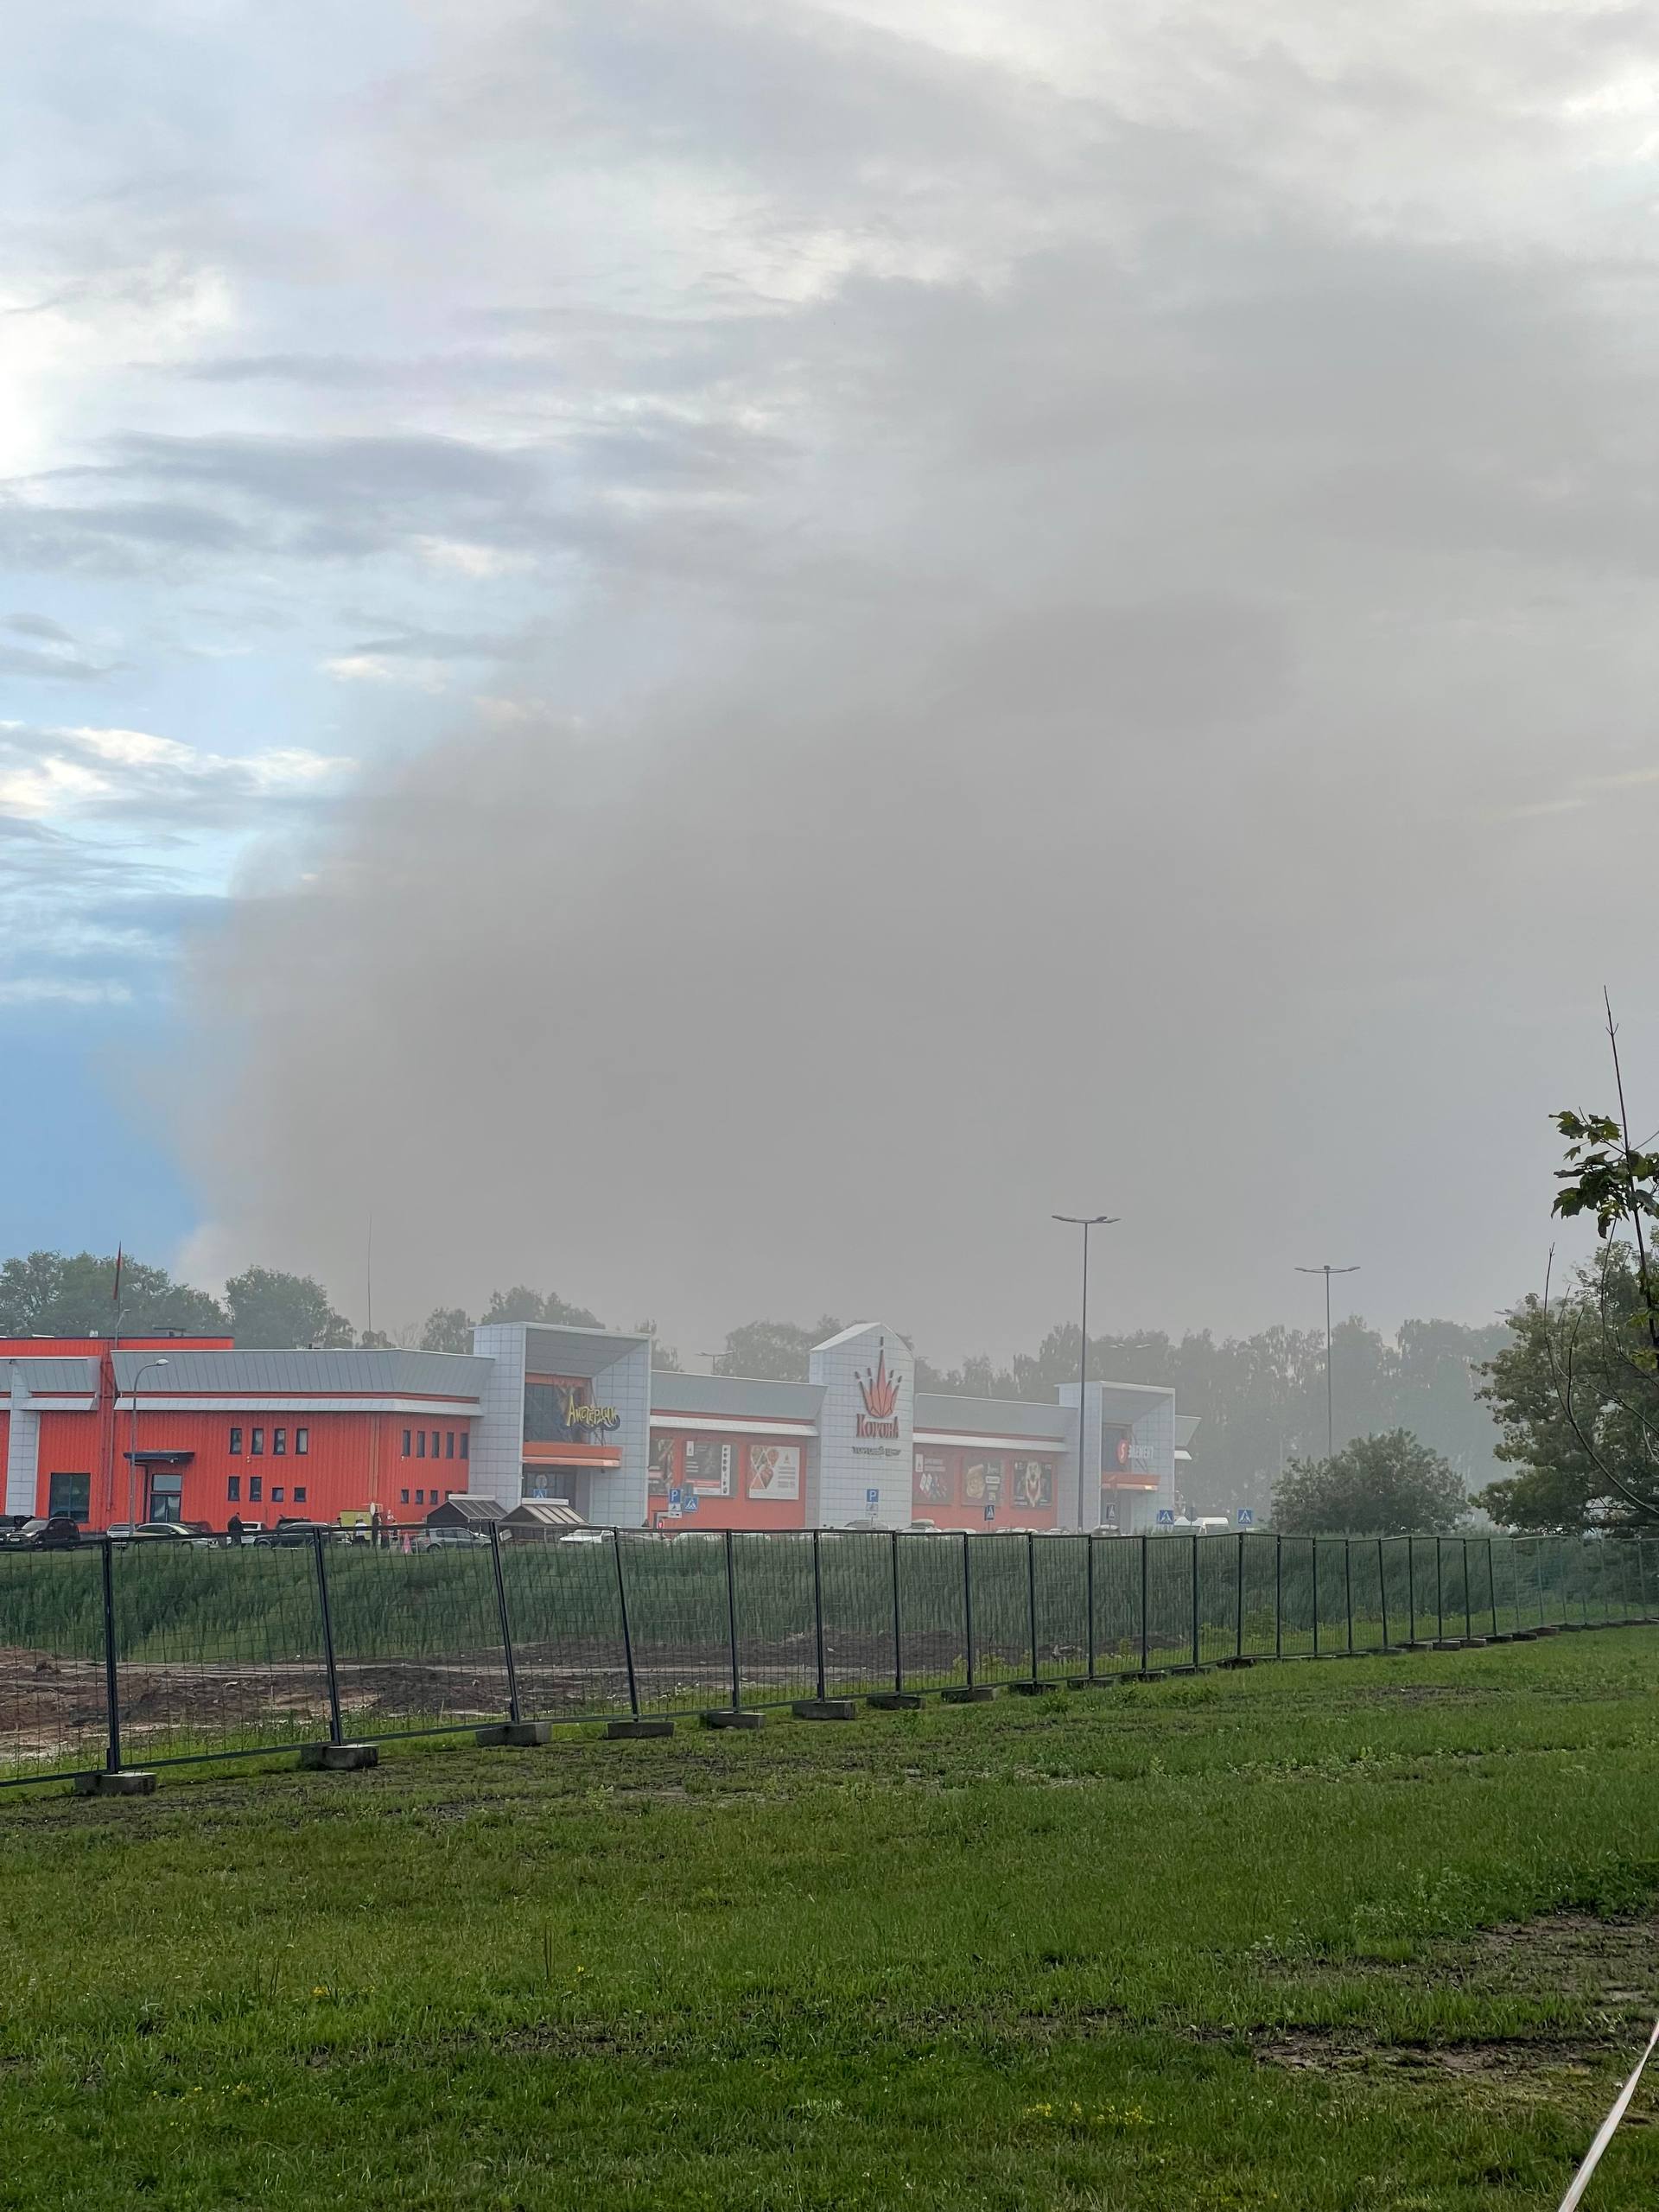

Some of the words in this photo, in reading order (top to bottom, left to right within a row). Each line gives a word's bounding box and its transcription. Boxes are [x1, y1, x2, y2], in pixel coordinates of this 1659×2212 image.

[856, 1414, 899, 1439] КОРОНА
[671, 1490, 678, 1502] P
[869, 1490, 877, 1502] P
